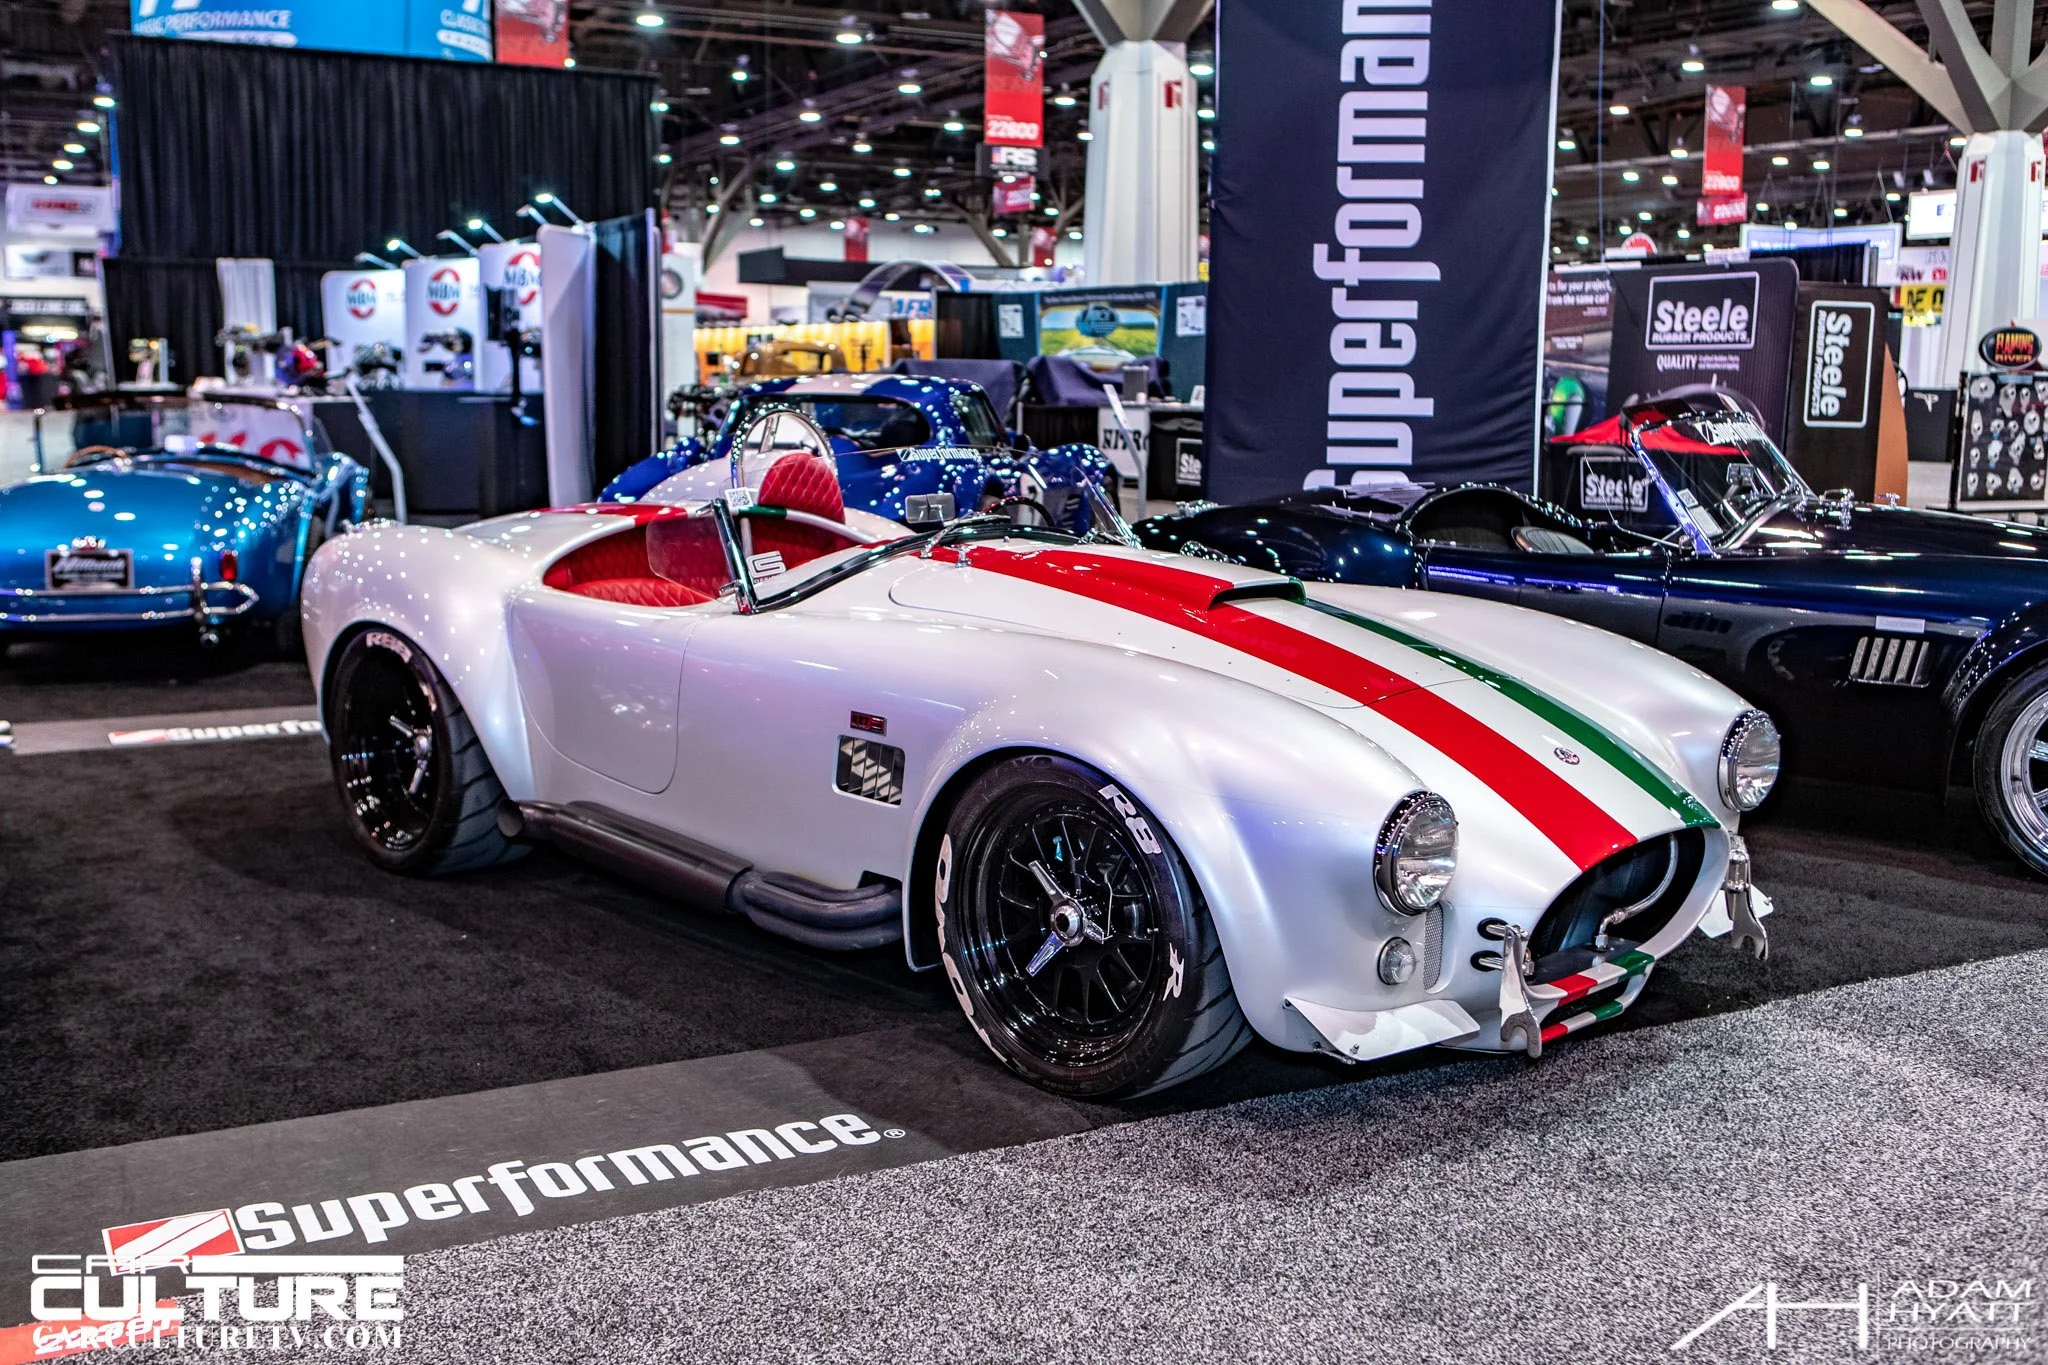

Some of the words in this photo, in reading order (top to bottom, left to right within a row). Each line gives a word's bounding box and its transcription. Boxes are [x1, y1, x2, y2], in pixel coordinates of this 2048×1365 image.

[166, 10, 291, 32] PERFORMANCE
[1654, 298, 1749, 333] Steele
[1693, 330, 1747, 343] PRODUCTS
[1657, 354, 1698, 372] QUALITY
[1820, 311, 1852, 417] Steele
[237, 1112, 882, 1251] Superformance
